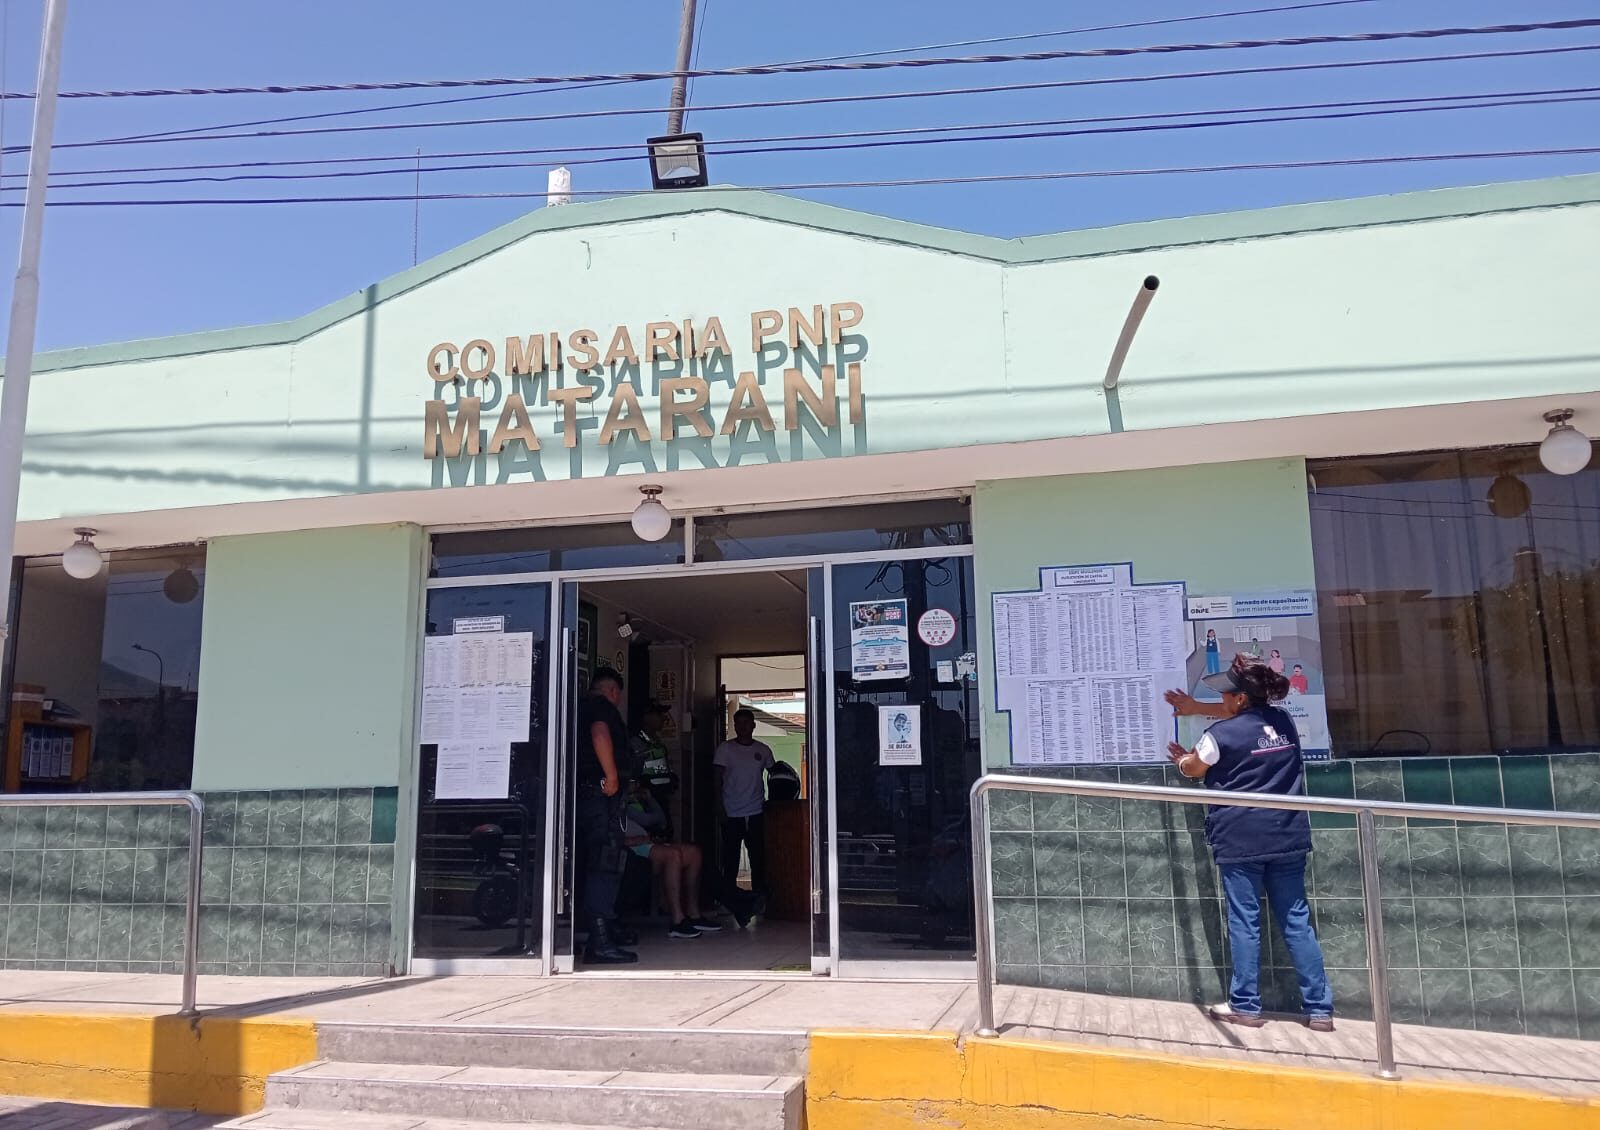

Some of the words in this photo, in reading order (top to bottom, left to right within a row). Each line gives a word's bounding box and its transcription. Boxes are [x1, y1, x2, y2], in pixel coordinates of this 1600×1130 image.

[427, 316, 732, 382] COMISARIA
[751, 301, 864, 353] PNP
[423, 363, 863, 460] MATARANI
[1269, 597, 1308, 605] capacitación
